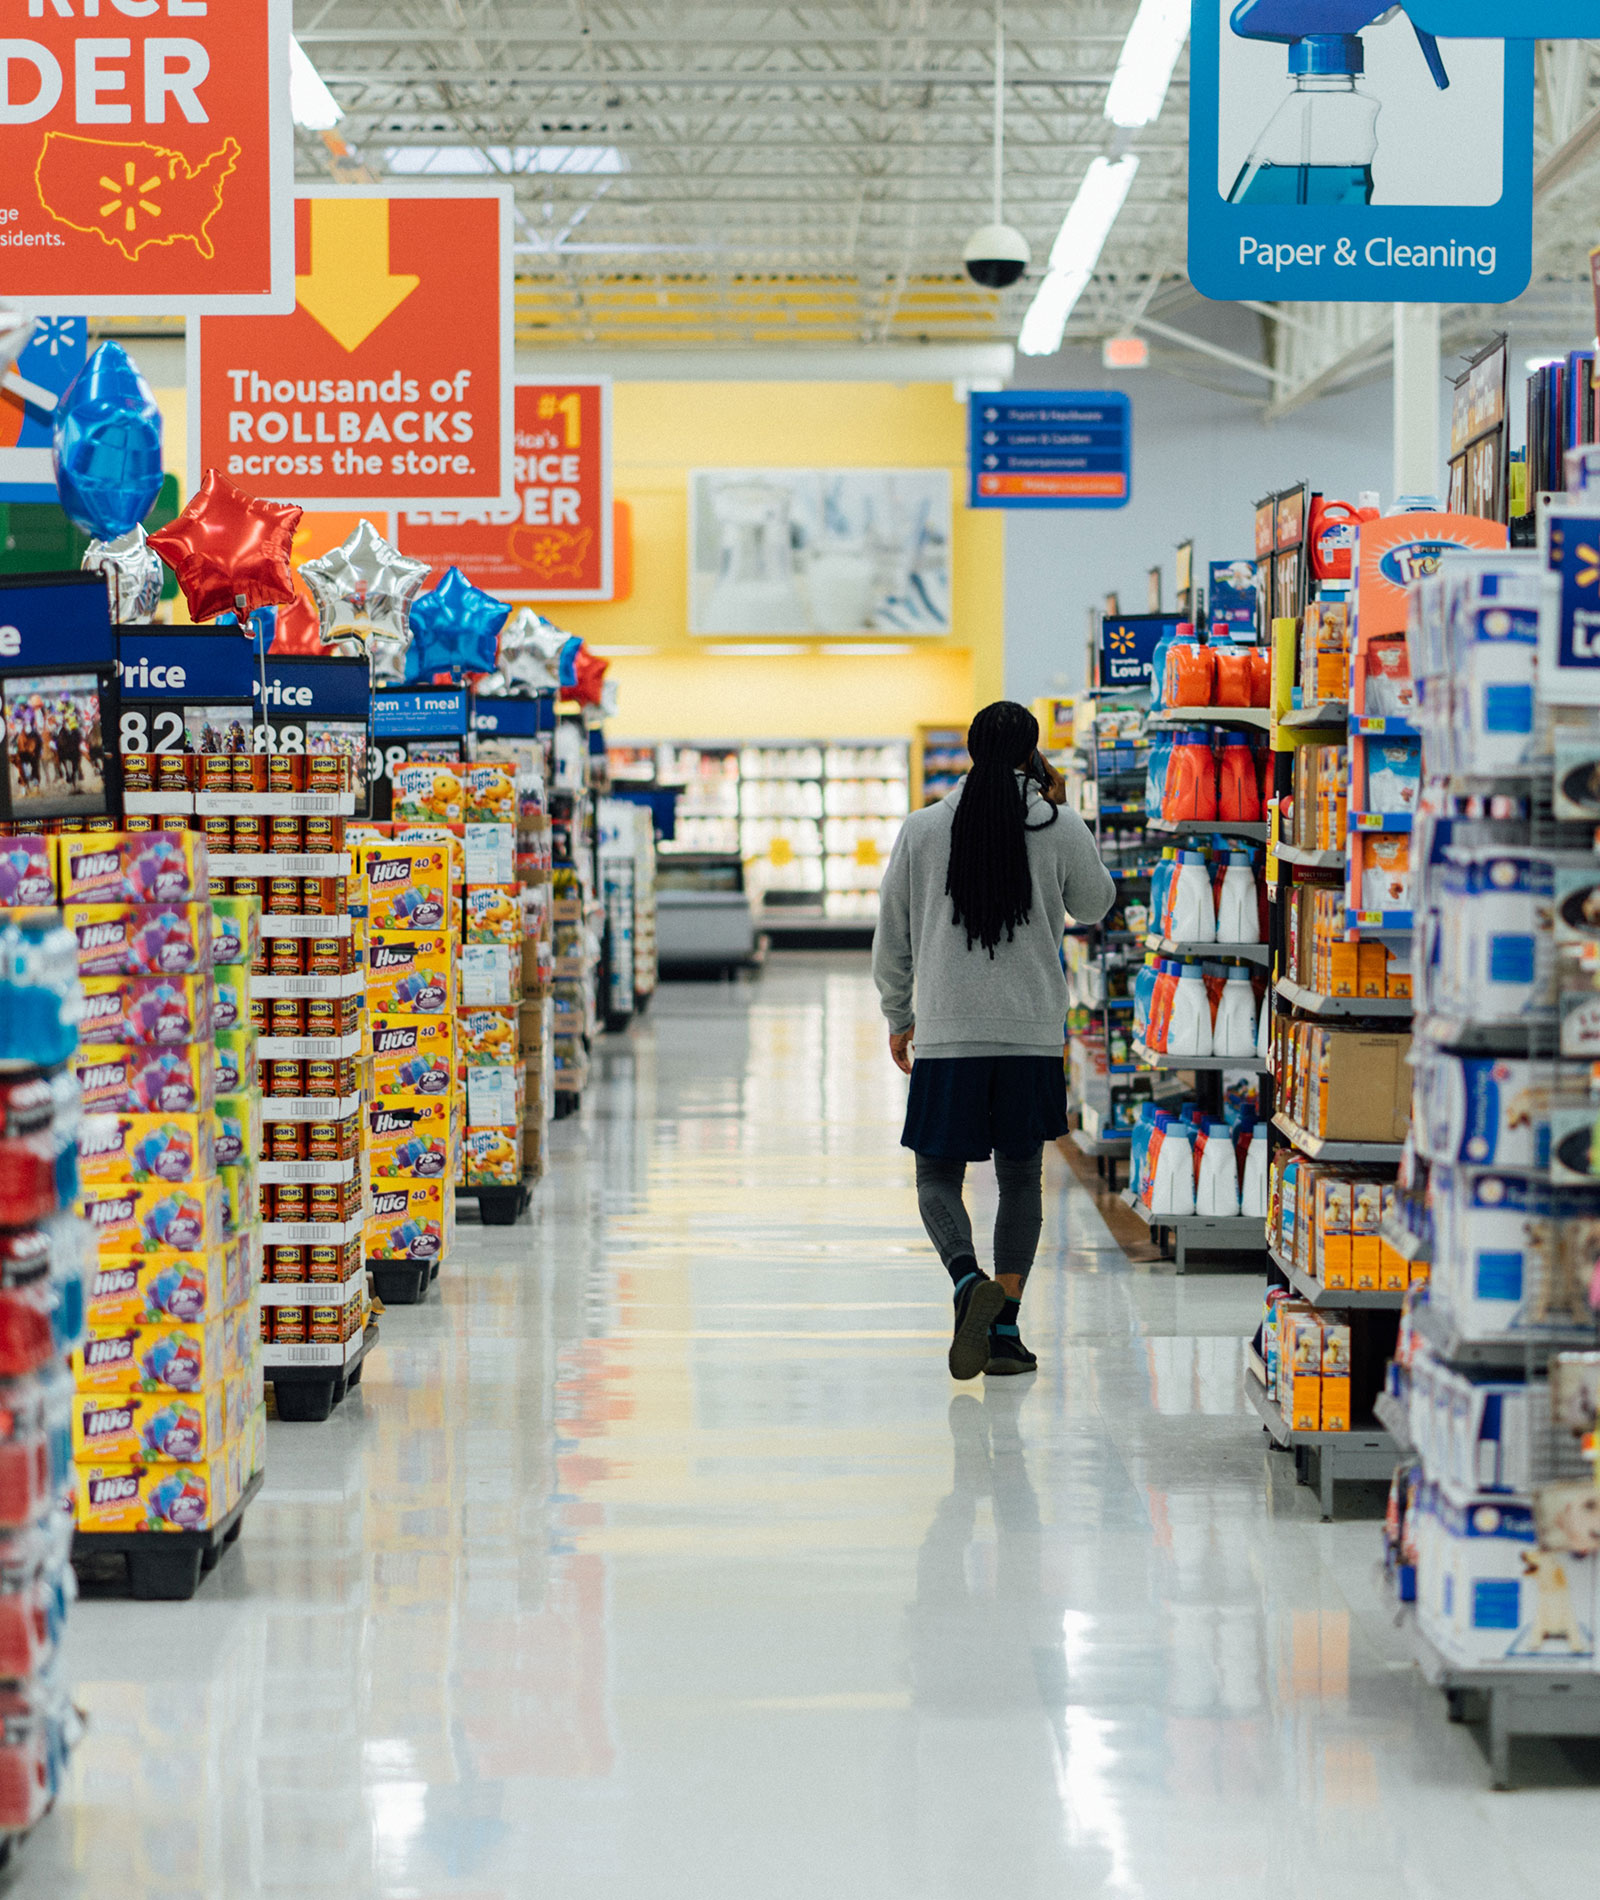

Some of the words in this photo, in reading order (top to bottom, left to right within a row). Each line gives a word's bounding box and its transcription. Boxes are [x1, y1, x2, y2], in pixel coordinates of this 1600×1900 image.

[0, 38, 210, 124] DER
[0, 231, 65, 246] sidents.
[1239, 236, 1326, 272] Paper
[1333, 237, 1357, 266] &
[1364, 237, 1497, 275] Cleaning
[227, 369, 420, 403] Thousands
[430, 369, 472, 403] of
[538, 392, 582, 448] #1
[229, 411, 474, 443] ROLLBACKS
[227, 454, 323, 475] across
[331, 447, 383, 475] the
[391, 450, 476, 475] store.
[1111, 664, 1142, 678] Low
[415, 696, 421, 710] 1
[424, 695, 459, 710] meal
[119, 712, 184, 753] 82
[253, 724, 305, 753] 88
[208, 759, 230, 768] BUSH'S
[313, 760, 336, 768] BUSH'S
[400, 770, 423, 787] Little
[471, 770, 492, 786] Little
[407, 780, 431, 793] Bites
[128, 819, 151, 828] BUSH'S
[164, 820, 186, 829] BUSH'S
[207, 820, 229, 829] BUSH'S
[235, 820, 257, 829] BUSH'S
[275, 821, 297, 829] BUSH'S
[308, 821, 330, 829] BUSH'S
[77, 854, 119, 880] HUG
[414, 858, 429, 870] 40
[371, 863, 409, 883] HUG
[235, 882, 256, 890] BUSH'S
[273, 882, 296, 890] BUSH'S
[471, 891, 492, 907] Little
[416, 903, 439, 914] 75%
[82, 925, 124, 949] HUG
[274, 943, 296, 951] BUSH'S
[316, 943, 338, 951] BUSH'S
[418, 942, 433, 953] 40
[419, 987, 442, 999] 75%
[274, 1003, 296, 1011] BUSH'S
[310, 1003, 332, 1011] BUSH'S
[469, 1013, 490, 1030] Little
[420, 1026, 436, 1037] 40
[378, 1031, 415, 1051] HUG
[275, 1064, 297, 1073] BUSH'S
[310, 1064, 332, 1073] BUSH'S
[83, 1065, 125, 1090] HUG
[422, 1072, 446, 1082] 75%
[312, 1128, 334, 1136] BUSH'S
[418, 1153, 442, 1164] 75%
[279, 1188, 302, 1197] BUSH'S
[313, 1188, 336, 1197] BUSH'S
[411, 1190, 427, 1200] 40
[373, 1196, 406, 1215] HUG
[91, 1200, 132, 1225] HUG
[413, 1235, 437, 1247] 75%
[277, 1249, 299, 1258] BUSH'S
[313, 1249, 335, 1258] BUSH'S
[94, 1270, 135, 1296] HUG
[278, 1310, 301, 1319] BUSH'S
[314, 1310, 337, 1319] BUSH'S
[89, 1340, 131, 1365] HUG
[83, 1400, 97, 1410] 20
[89, 1410, 131, 1435] HUG
[89, 1468, 103, 1478] 20
[95, 1478, 137, 1503] HUG
